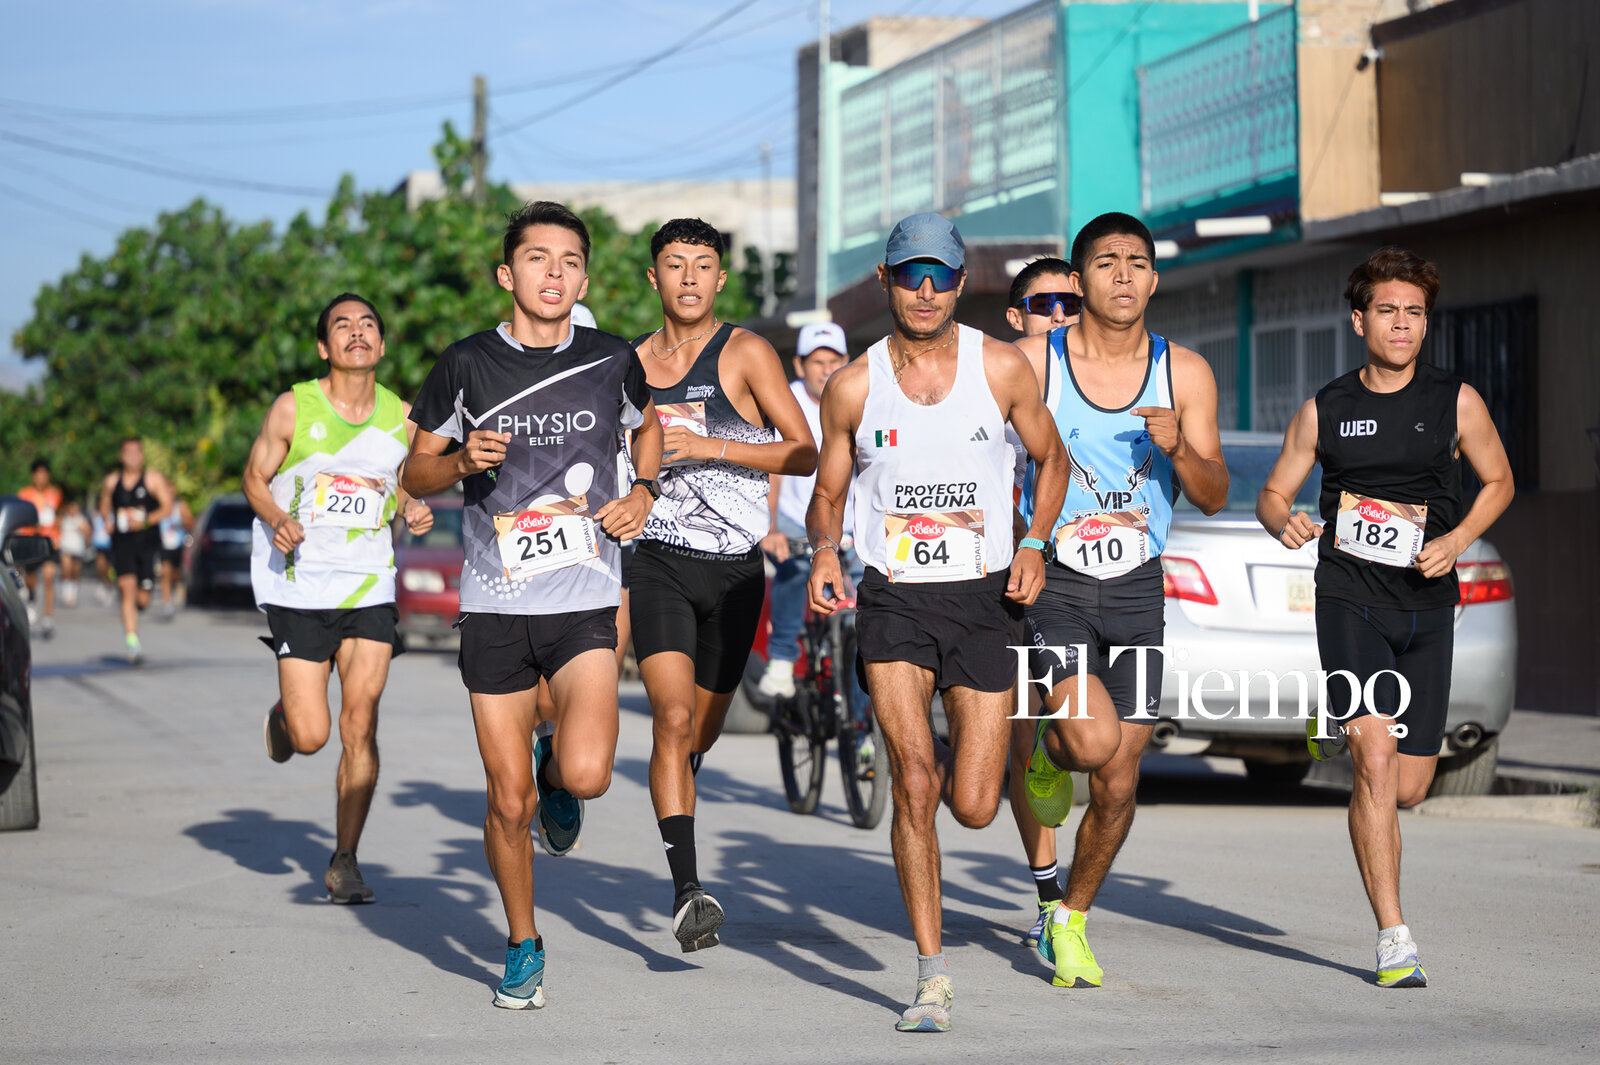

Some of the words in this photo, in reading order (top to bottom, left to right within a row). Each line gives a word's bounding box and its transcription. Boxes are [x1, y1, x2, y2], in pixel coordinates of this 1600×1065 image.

[498, 410, 596, 435] PHYSIO
[1340, 420, 1378, 437] UJED
[529, 436, 564, 446] ELITE
[895, 482, 977, 496] PROYECTO
[327, 495, 366, 514] 220
[896, 494, 976, 509] LAGUNA
[1095, 492, 1132, 509] VIP
[1359, 506, 1390, 520] Dorado
[517, 515, 552, 530] Dorado
[909, 523, 944, 535] Dorado
[1078, 523, 1110, 538] Dorado
[1353, 520, 1398, 550] 182
[517, 528, 568, 560] 251
[914, 540, 950, 565] 64
[1077, 538, 1123, 567] 110
[974, 534, 983, 575] MEDALLA
